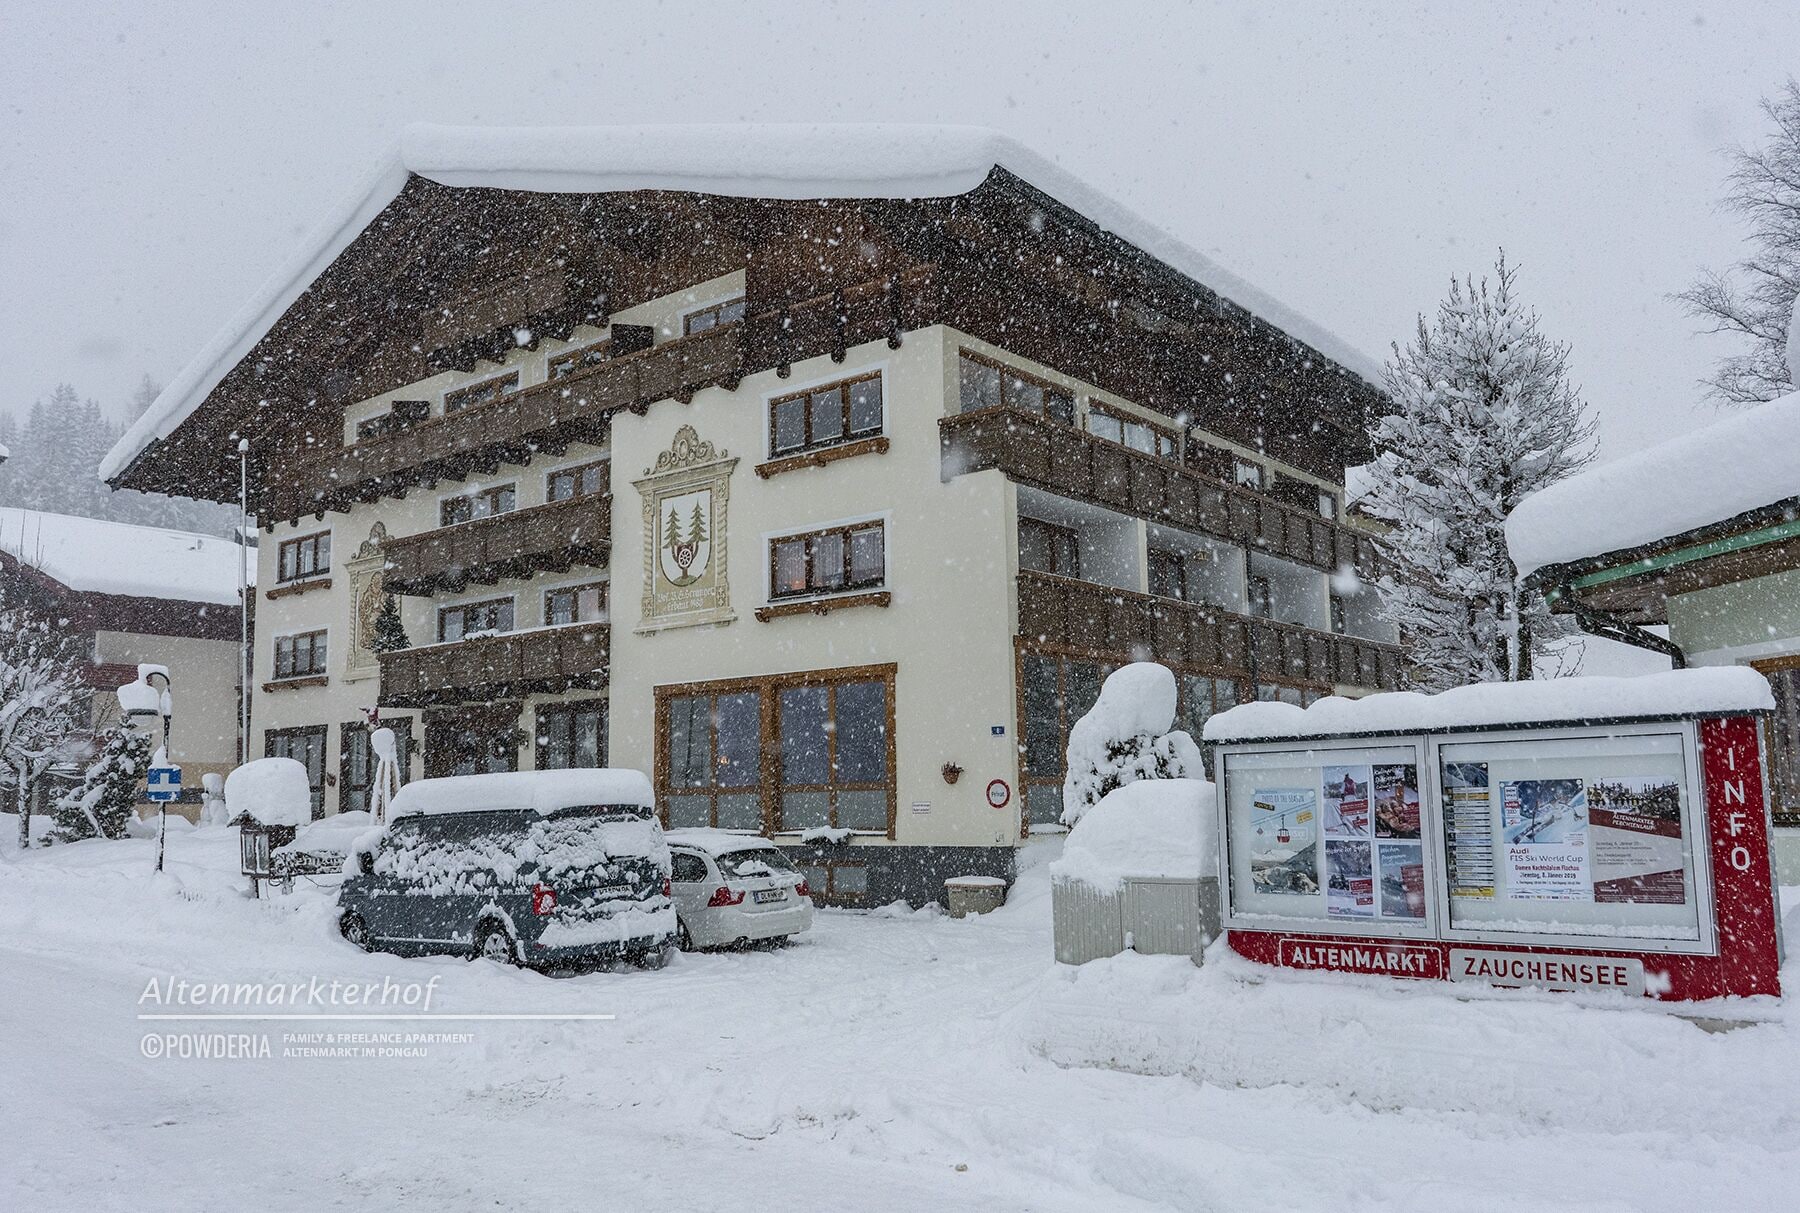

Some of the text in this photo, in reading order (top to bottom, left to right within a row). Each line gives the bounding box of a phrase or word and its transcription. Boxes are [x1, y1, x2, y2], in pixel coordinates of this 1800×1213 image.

[1723, 747, 1751, 871] INFO
[1612, 814, 1655, 825] ALTENMARKTER
[1509, 847, 1530, 855] Audi
[1567, 855, 1584, 863] Cup
[1291, 946, 1427, 973] ALTENMARKT
[1463, 956, 1628, 987] ZAUCHENSEE
